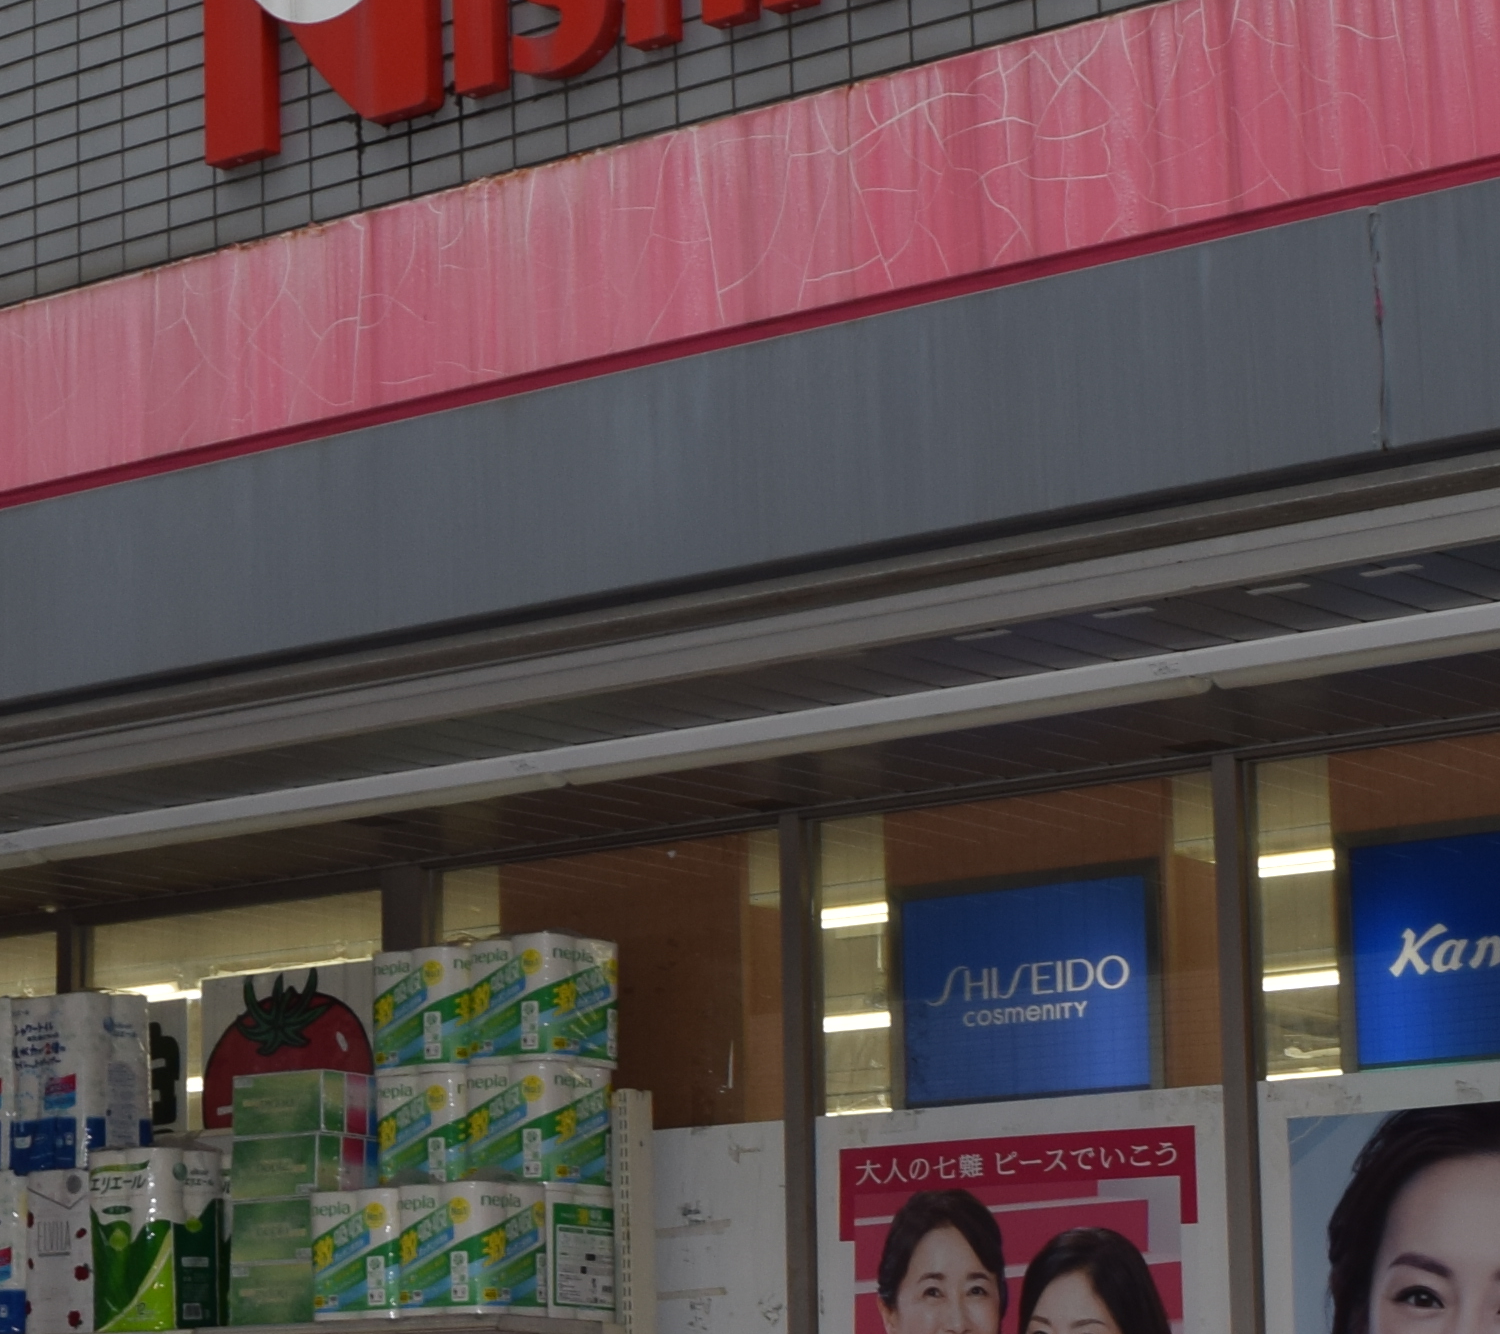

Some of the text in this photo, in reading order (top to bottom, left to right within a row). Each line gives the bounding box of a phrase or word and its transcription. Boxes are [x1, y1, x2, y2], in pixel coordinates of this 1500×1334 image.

[926, 955, 1131, 1007] SHISEIDO
[855, 1140, 1180, 1188] 大人の七難 ピースでいこう
[481, 1192, 522, 1210] nepia
